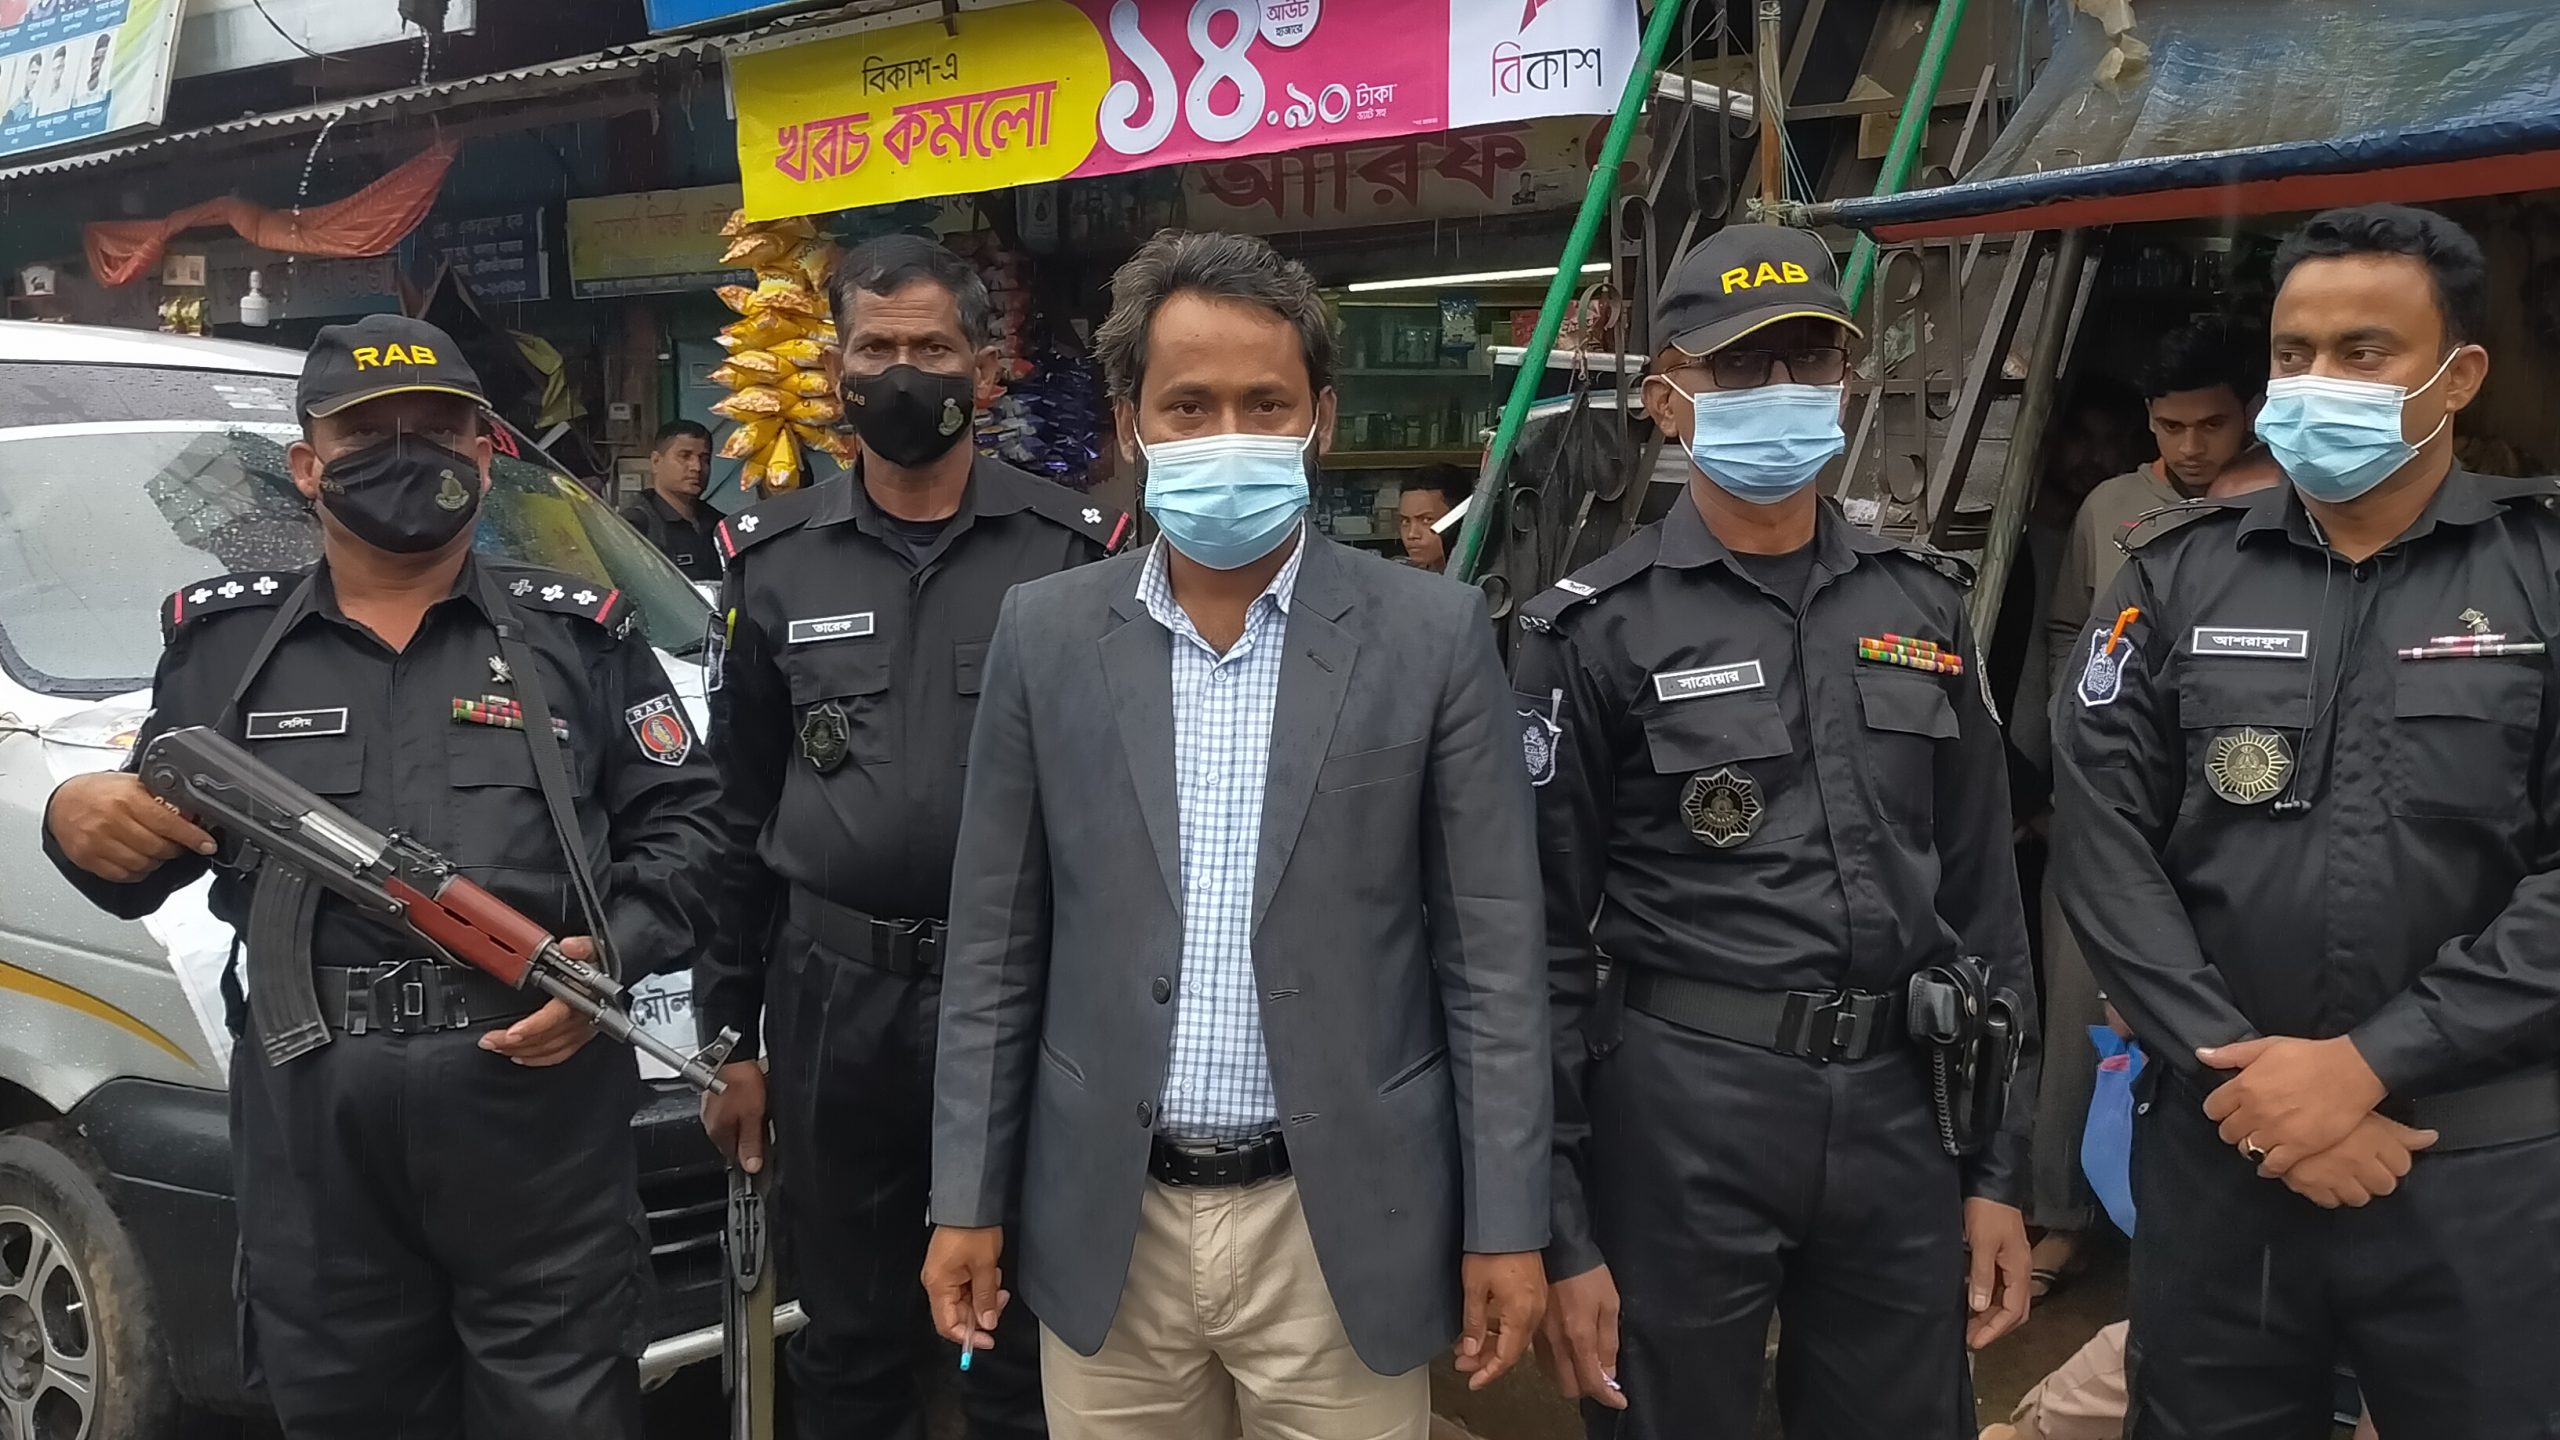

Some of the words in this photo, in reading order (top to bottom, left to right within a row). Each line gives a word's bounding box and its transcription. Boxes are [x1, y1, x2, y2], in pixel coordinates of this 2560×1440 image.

[862, 52, 958, 96] বিকাশ-এ
[1492, 41, 1602, 97] বিকাশ
[1355, 83, 1394, 107] টাকা
[774, 112, 870, 182] খরচ
[882, 80, 1058, 166] কমলো
[1721, 261, 1809, 295] RAB
[352, 343, 438, 371] RAB
[811, 620, 853, 633] তারেক
[2211, 635, 2291, 651] আশরাফুল
[1677, 670, 1740, 690] সারোয়ার
[632, 700, 665, 721] RAB
[278, 717, 313, 729] সেলিম
